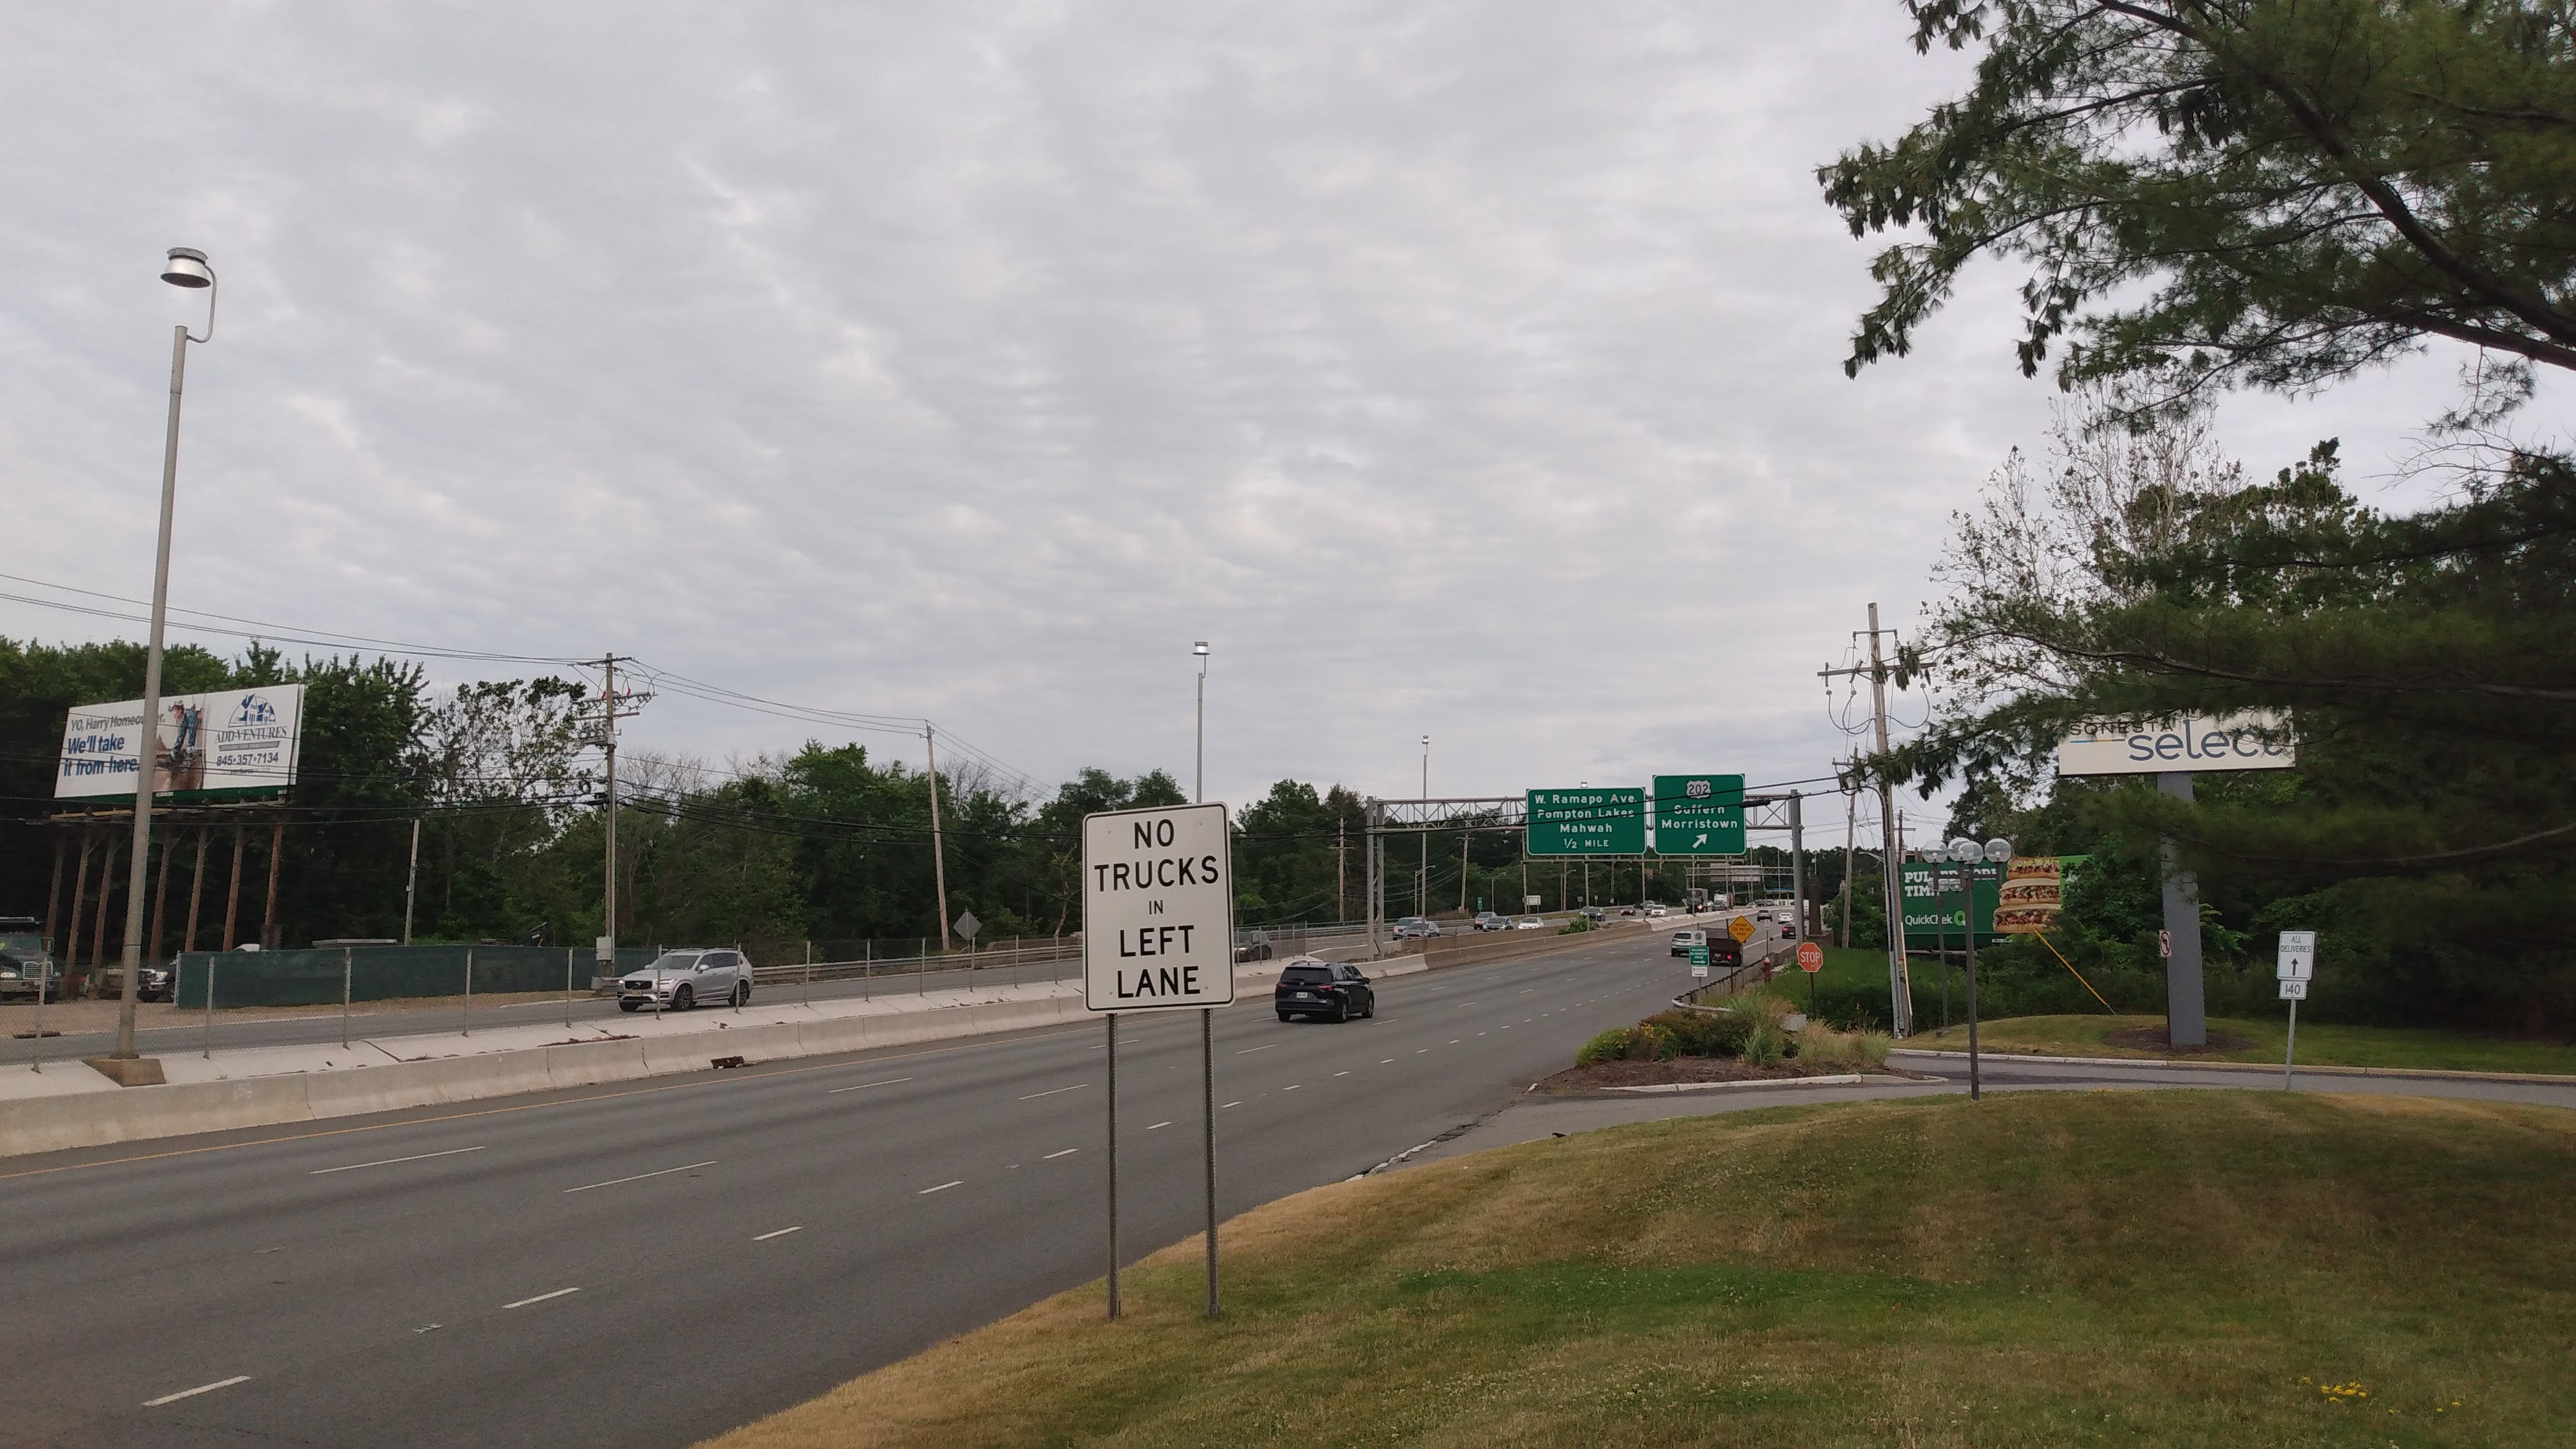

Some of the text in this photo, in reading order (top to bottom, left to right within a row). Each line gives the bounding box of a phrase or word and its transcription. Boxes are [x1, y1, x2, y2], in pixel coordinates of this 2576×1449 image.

[71, 720, 84, 732] YO,
[86, 718, 110, 732] Harry
[67, 733, 124, 754] We'll take
[2128, 720, 2284, 761] select
[63, 755, 140, 777] it from here.
[1689, 784, 1708, 794] 202
[1534, 793, 1637, 805] W. Ramapo Ave.
[1537, 807, 1635, 820] Pompton Lakes
[1674, 804, 1725, 815] Suffern
[1560, 822, 1612, 833] Mahwah
[1661, 819, 1738, 829] Morristown
[1134, 819, 1175, 849] NO
[1585, 839, 1609, 848] MILE
[1094, 855, 1219, 892] TRUCKS
[1149, 900, 1164, 915] IN
[1120, 925, 1194, 957] LEFT
[2281, 945, 2311, 953] DELIVERIES
[1800, 951, 1821, 963] STOP
[1117, 965, 1201, 998] LANE
[2285, 984, 2300, 994] 140
